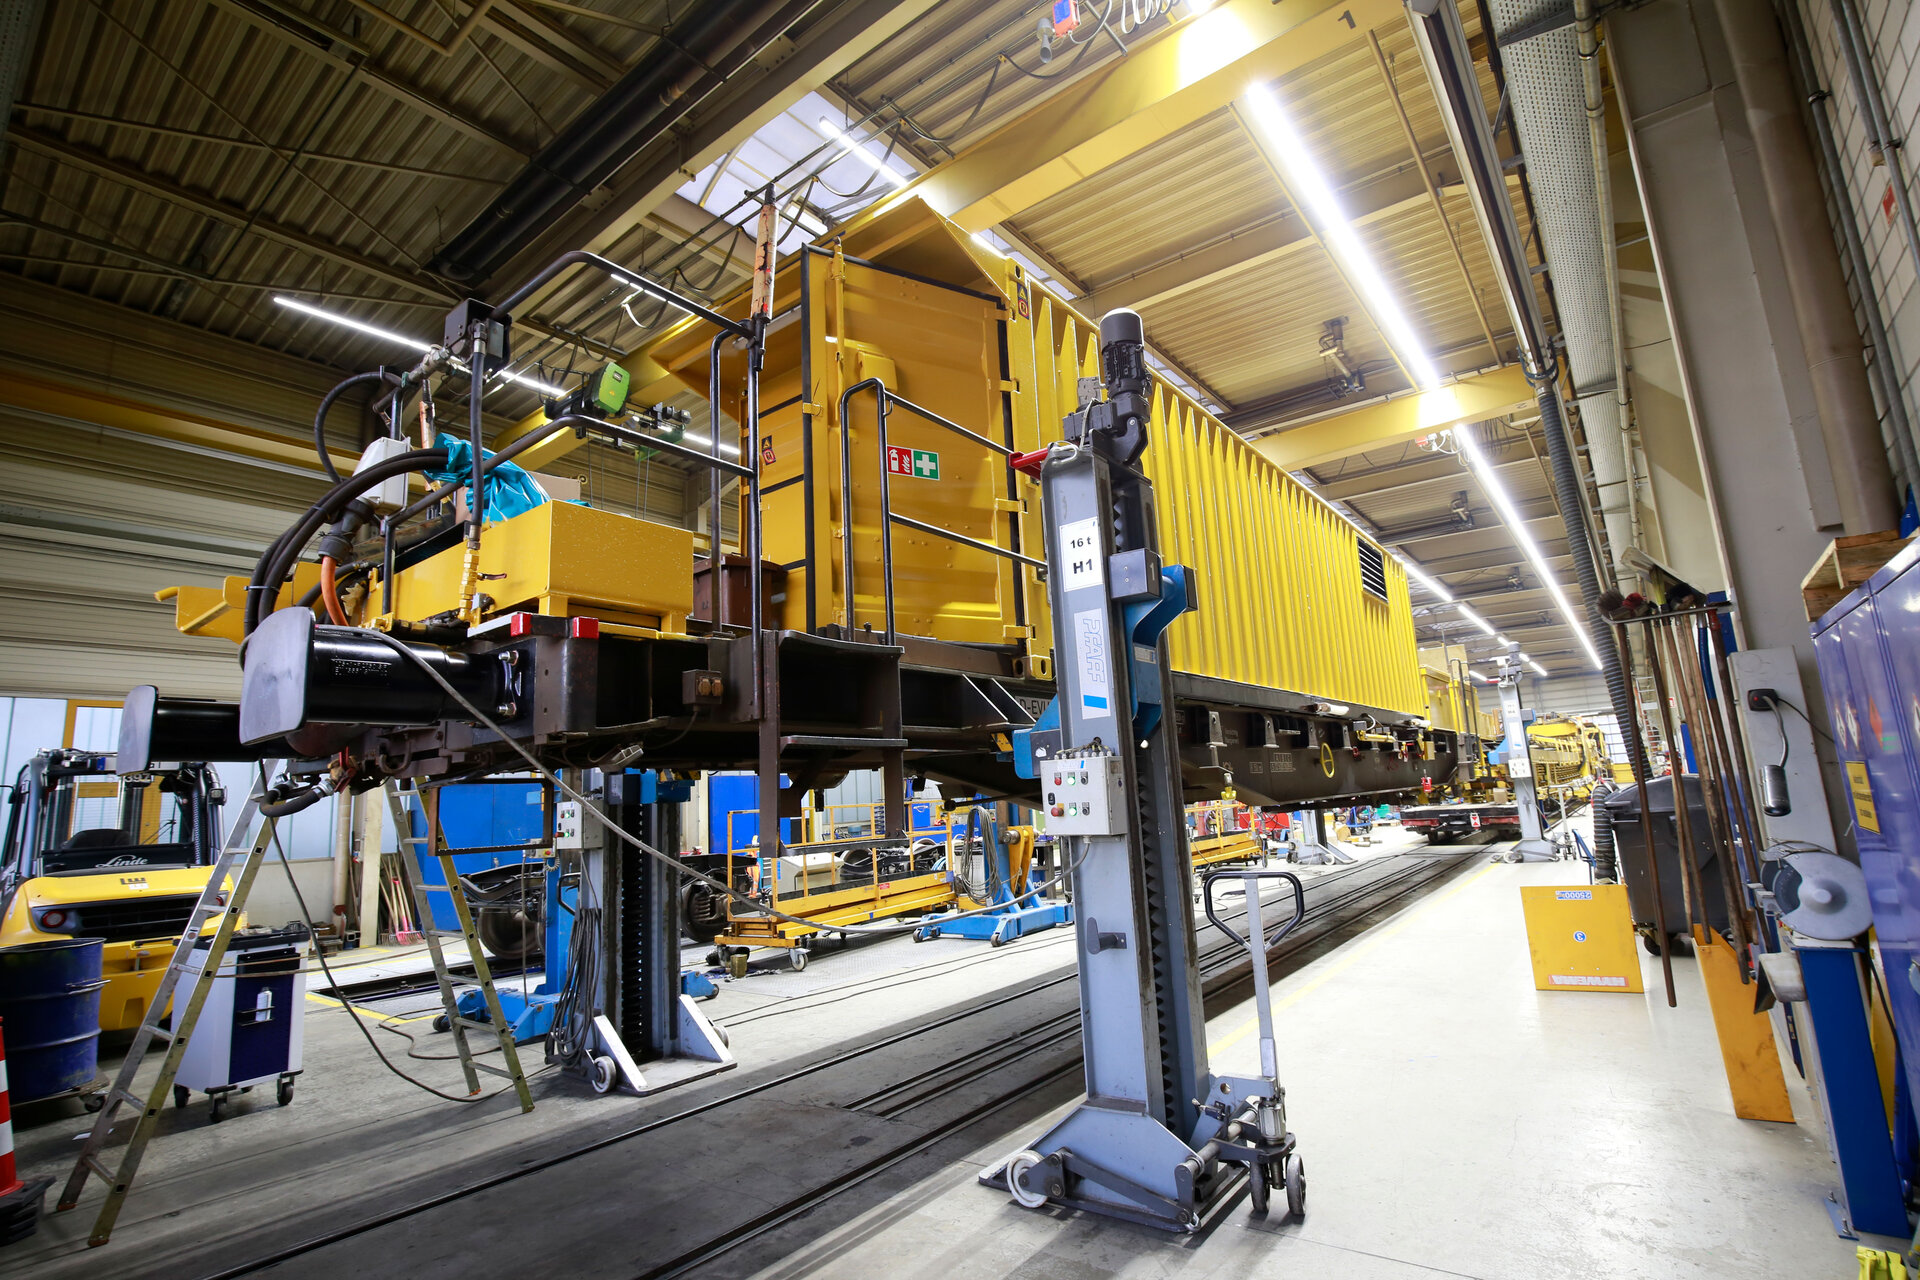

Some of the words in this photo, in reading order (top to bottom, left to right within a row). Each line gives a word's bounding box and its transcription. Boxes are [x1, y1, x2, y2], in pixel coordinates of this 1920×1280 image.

[1338, 10, 1356, 29] 1
[1070, 538, 1084, 549] 16
[1086, 536, 1092, 545] t
[1073, 558, 1093, 574] H1
[1149, 562, 1155, 581] 1
[1083, 618, 1106, 683] PFAFF
[95, 855, 149, 869] Linde
